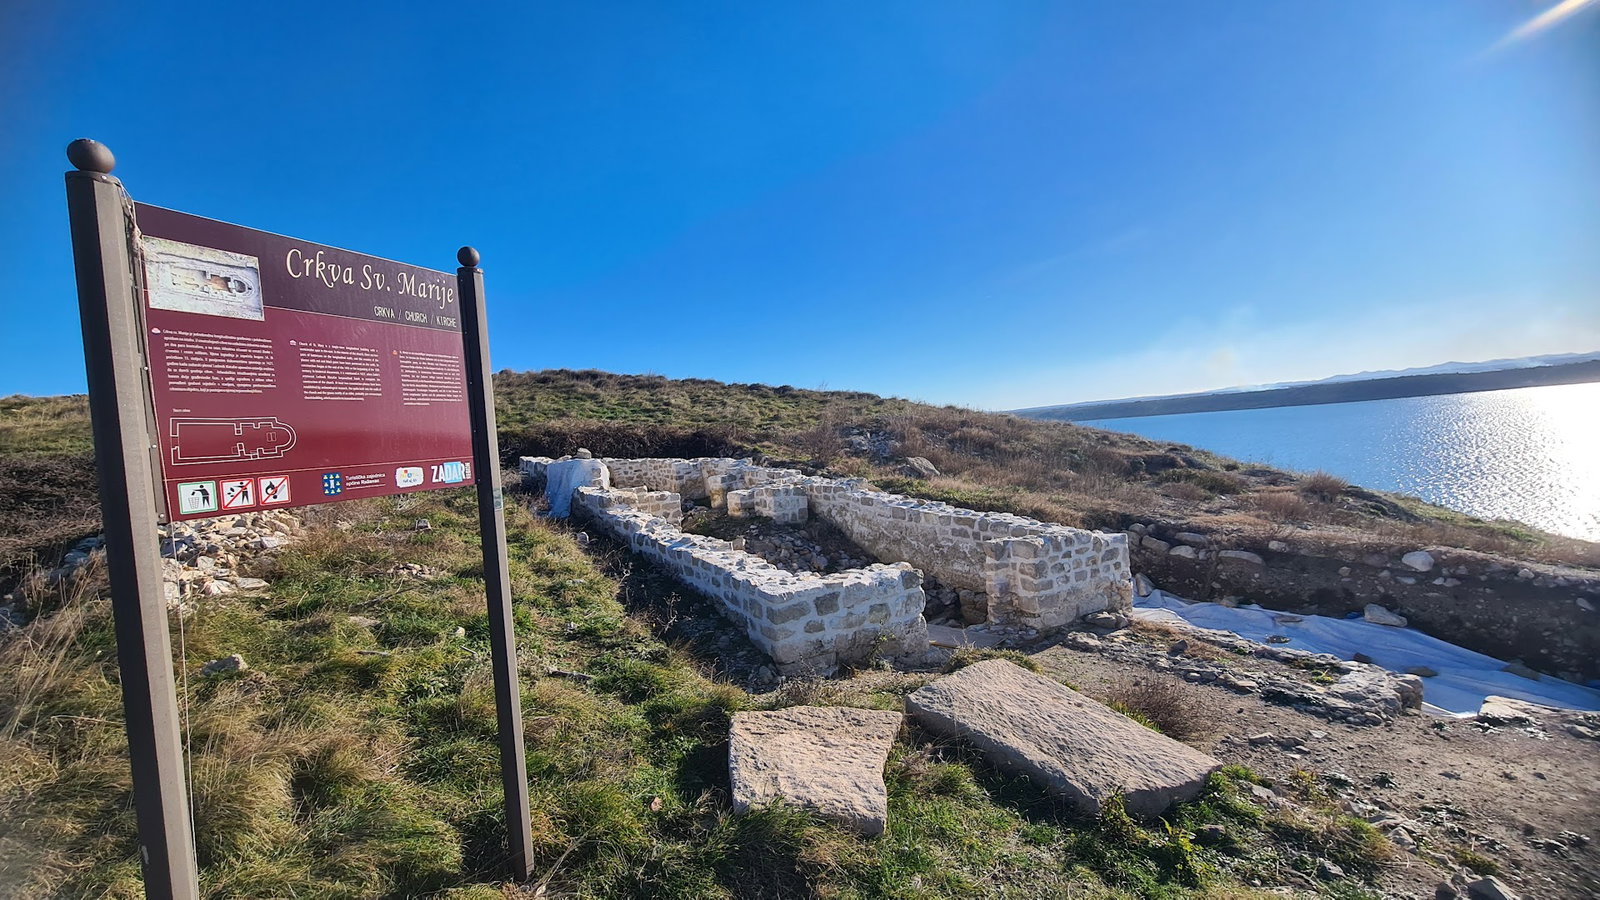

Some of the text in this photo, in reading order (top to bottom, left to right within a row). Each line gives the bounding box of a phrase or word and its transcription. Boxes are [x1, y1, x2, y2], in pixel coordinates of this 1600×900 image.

[286, 248, 454, 310] Crkva Sv. Marije
[373, 305, 396, 319] CRKVA
[404, 310, 428, 324] CHURCH
[436, 315, 457, 328] KIRCHE
[431, 462, 466, 483] ZADAR
